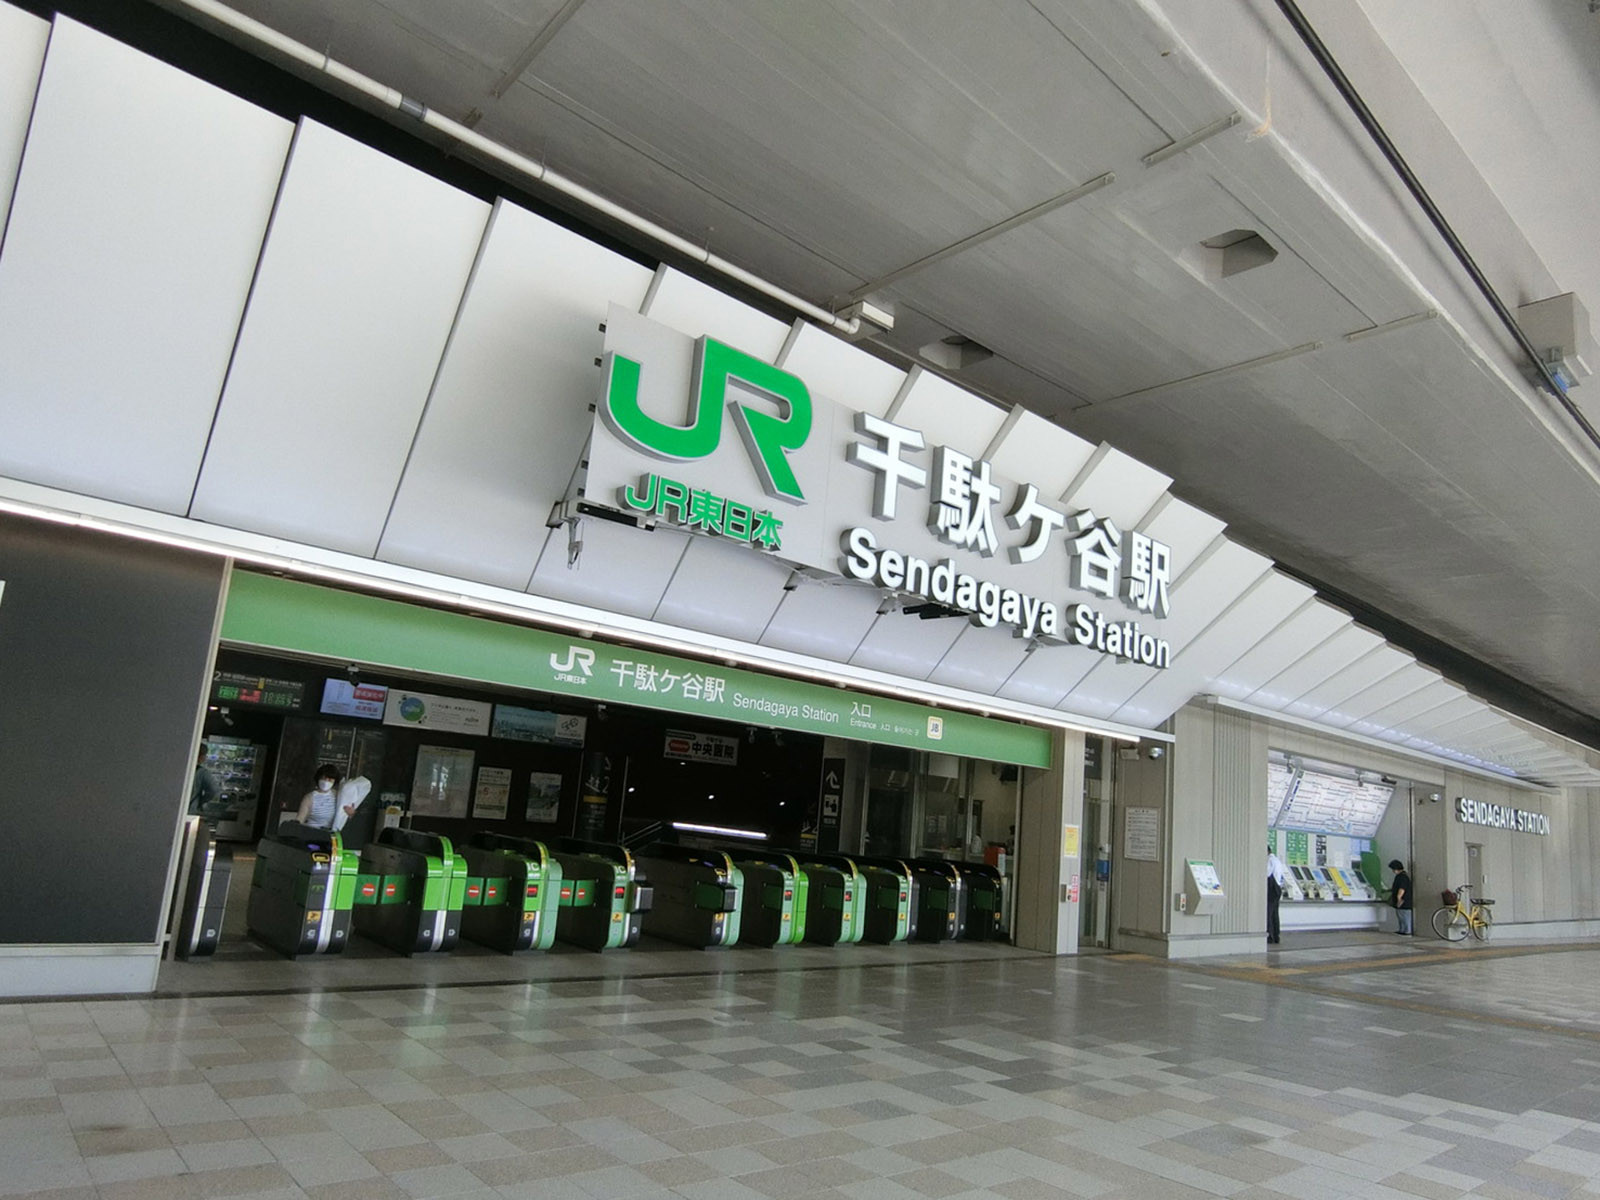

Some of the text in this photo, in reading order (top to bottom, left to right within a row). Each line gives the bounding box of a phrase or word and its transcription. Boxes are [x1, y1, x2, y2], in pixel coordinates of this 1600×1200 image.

[604, 334, 812, 503] JR
[622, 472, 784, 549] JR東日本
[850, 411, 1171, 619] 千駄ケ谷駅
[846, 526, 1171, 670] Sendagaya Station
[550, 645, 596, 677] JR
[554, 672, 588, 685] JR東日本
[610, 658, 840, 723] 千駄ケ谷駅 Sendagaya Station
[850, 701, 872, 718] 入口
[850, 717, 877, 730] Entrance
[1460, 797, 1550, 835] SENDAGAYA STATION
